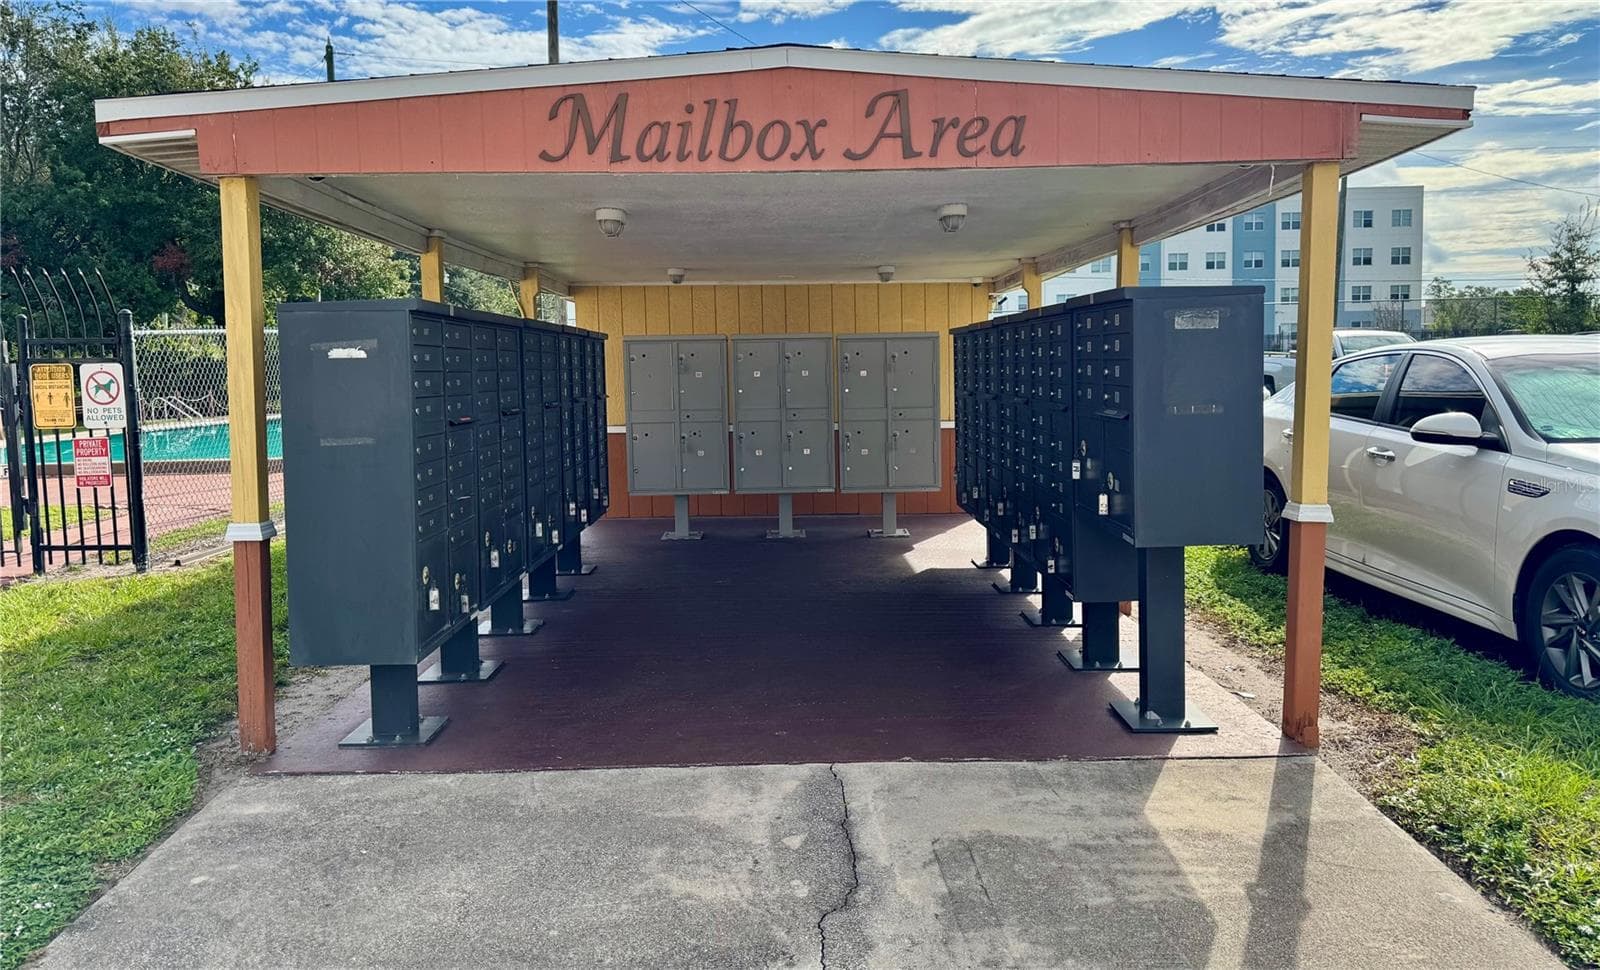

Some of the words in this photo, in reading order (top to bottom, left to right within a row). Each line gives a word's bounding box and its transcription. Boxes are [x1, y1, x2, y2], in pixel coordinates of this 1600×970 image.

[538, 92, 828, 164] Mailbox
[842, 88, 1027, 161] Area
[87, 407, 99, 415] NO
[79, 440, 103, 448] PRIVATE
[76, 447, 107, 457] PROPERTY
